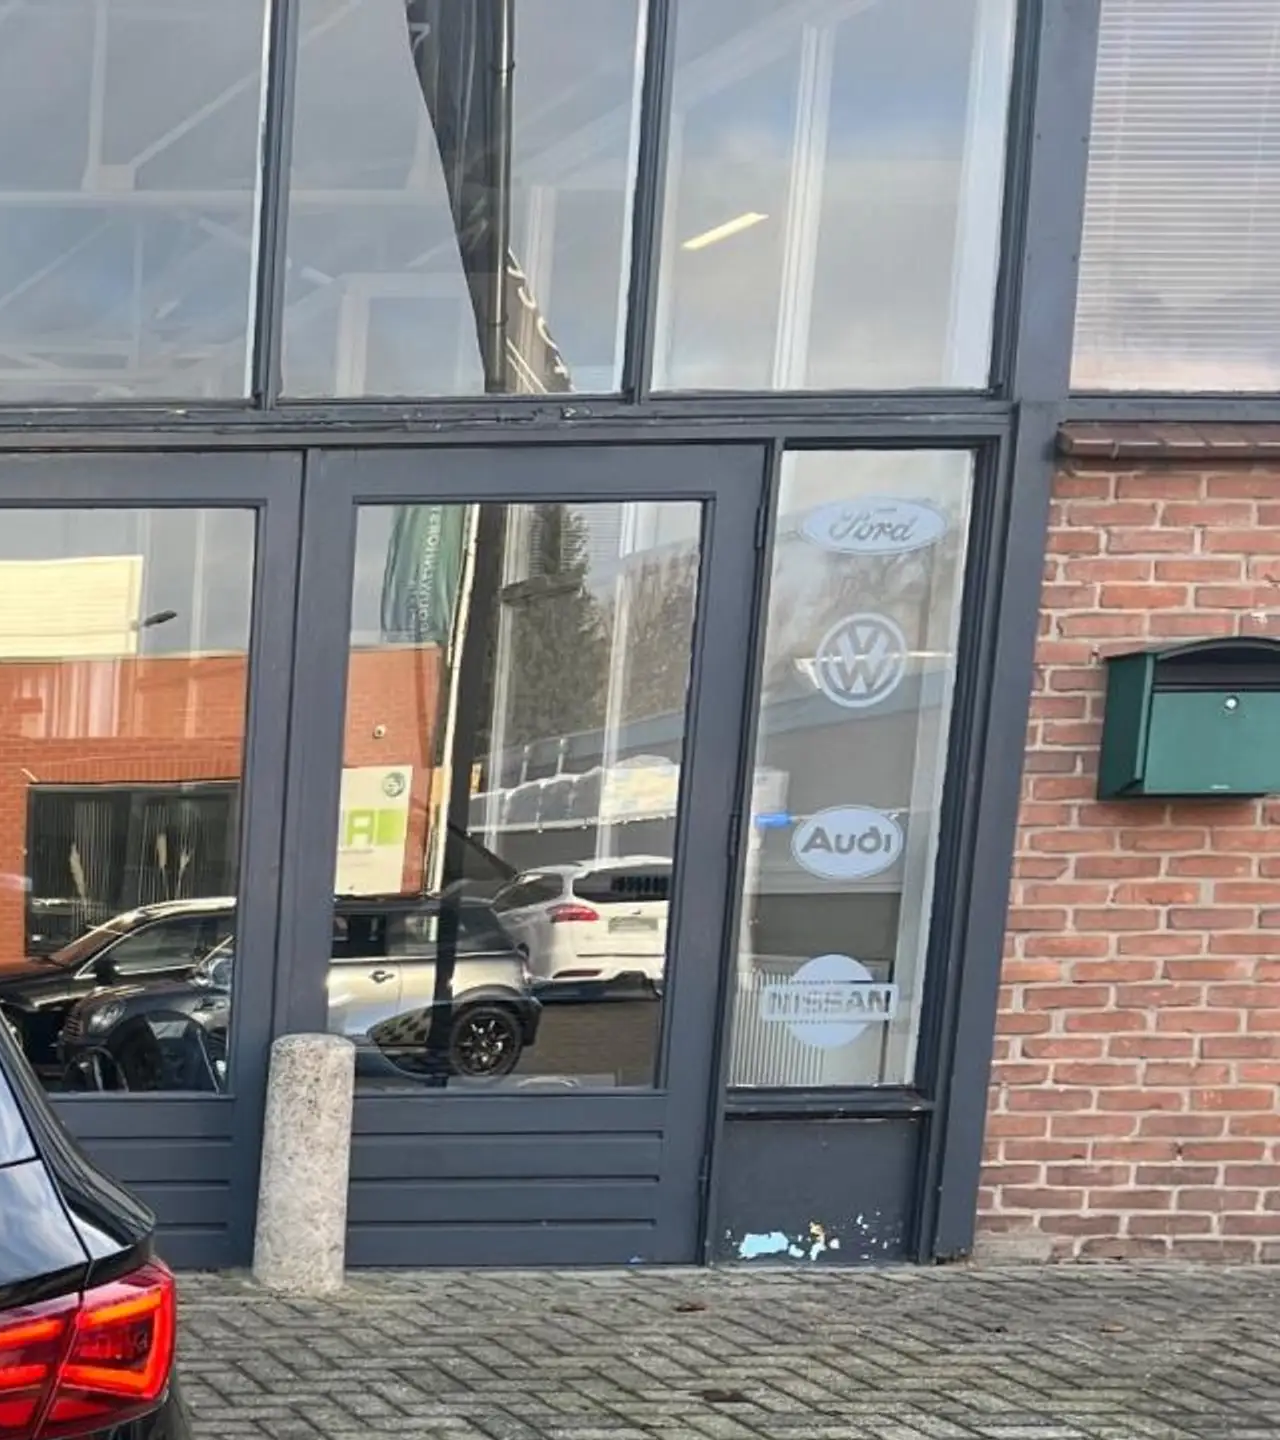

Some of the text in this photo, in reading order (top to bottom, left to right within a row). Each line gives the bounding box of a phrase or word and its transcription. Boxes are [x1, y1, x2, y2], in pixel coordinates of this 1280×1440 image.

[829, 508, 919, 542] Ford
[801, 826, 892, 854] Audi
[768, 990, 891, 1015] NISSAN
